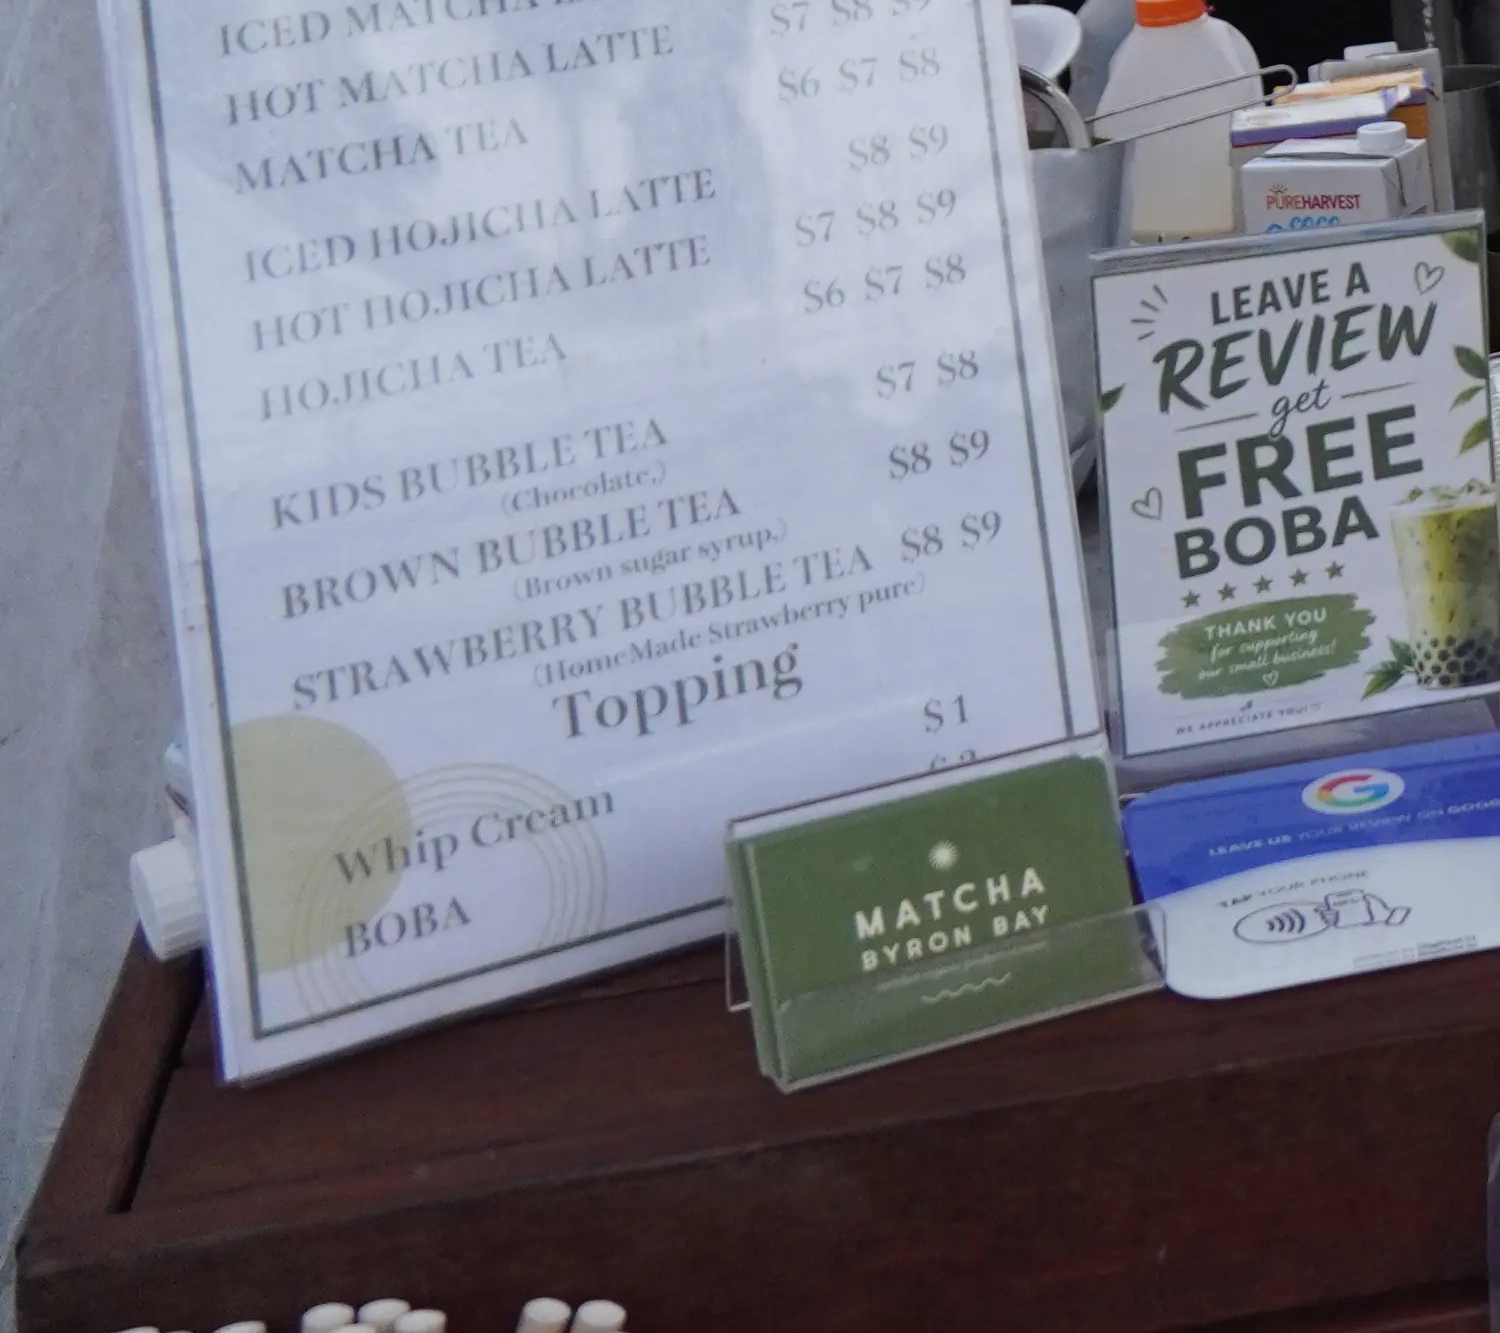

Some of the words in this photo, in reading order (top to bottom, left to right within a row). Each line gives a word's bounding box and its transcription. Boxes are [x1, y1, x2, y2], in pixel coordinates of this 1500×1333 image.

[220, 12, 331, 57] ICED
[228, 77, 327, 127] HOT
[337, 48, 536, 107] MATCHA
[545, 24, 674, 74] LATTE
[769, 0, 811, 38] $7
[236, 132, 437, 191] MATCHA
[451, 117, 530, 157] TEA
[777, 66, 821, 105] $6
[838, 56, 879, 92] $7
[897, 48, 942, 81] $8
[246, 231, 357, 284] ICED
[370, 188, 580, 260] HOJICHA
[590, 167, 717, 219] LATTE
[848, 134, 892, 173] $8
[908, 124, 949, 160] $9
[1266, 193, 1361, 210] PUREHARVEST
[252, 303, 353, 352] HOT
[363, 264, 572, 330] HOJICHA
[583, 235, 711, 288] LATTE
[794, 209, 836, 245] $7
[855, 199, 900, 237] $8
[916, 187, 958, 224] $9
[1210, 268, 1331, 326] LEAVE
[1345, 261, 1371, 295] A
[260, 351, 475, 422] HOJICHA
[492, 333, 568, 374] TEA
[802, 279, 846, 314] $6
[864, 264, 904, 301] $7
[924, 253, 967, 289] $8
[1152, 301, 1438, 415] REVIEW
[272, 478, 387, 530] KIDS
[399, 433, 577, 503] BUBBLE
[585, 417, 669, 458] TEA
[875, 360, 916, 398] $7
[936, 350, 980, 385] $8
[1267, 375, 1332, 441] get
[1177, 404, 1425, 520] FREE
[282, 547, 460, 620] BROWN
[476, 501, 648, 575] BUBBLE
[657, 488, 742, 534] TEA
[888, 442, 932, 479] $8
[949, 429, 990, 467] $9
[1174, 495, 1380, 580] BOBA
[292, 607, 604, 711] STRAWBERRY
[619, 563, 787, 632] BUBBLE
[801, 545, 873, 586] TEA
[900, 525, 944, 562] $8
[960, 510, 1002, 548] $9
[515, 562, 614, 602] (Brown
[619, 545, 692, 575] sugar
[1198, 668, 1224, 680] our
[1228, 655, 1268, 674] small
[1272, 638, 1338, 663] business!
[1203, 615, 1276, 641] THANK
[1284, 606, 1327, 627] YOU
[1210, 643, 1233, 664] for
[1239, 629, 1319, 654] supporting
[556, 642, 804, 738] Topping
[1199, 710, 1274, 731] APPRECIATE
[334, 836, 459, 886] Whip
[472, 791, 616, 852] Cream
[344, 897, 472, 959] BOBA
[855, 866, 1046, 940] MATCHA
[861, 924, 972, 972] BYRON
[992, 904, 1048, 937] BAY
